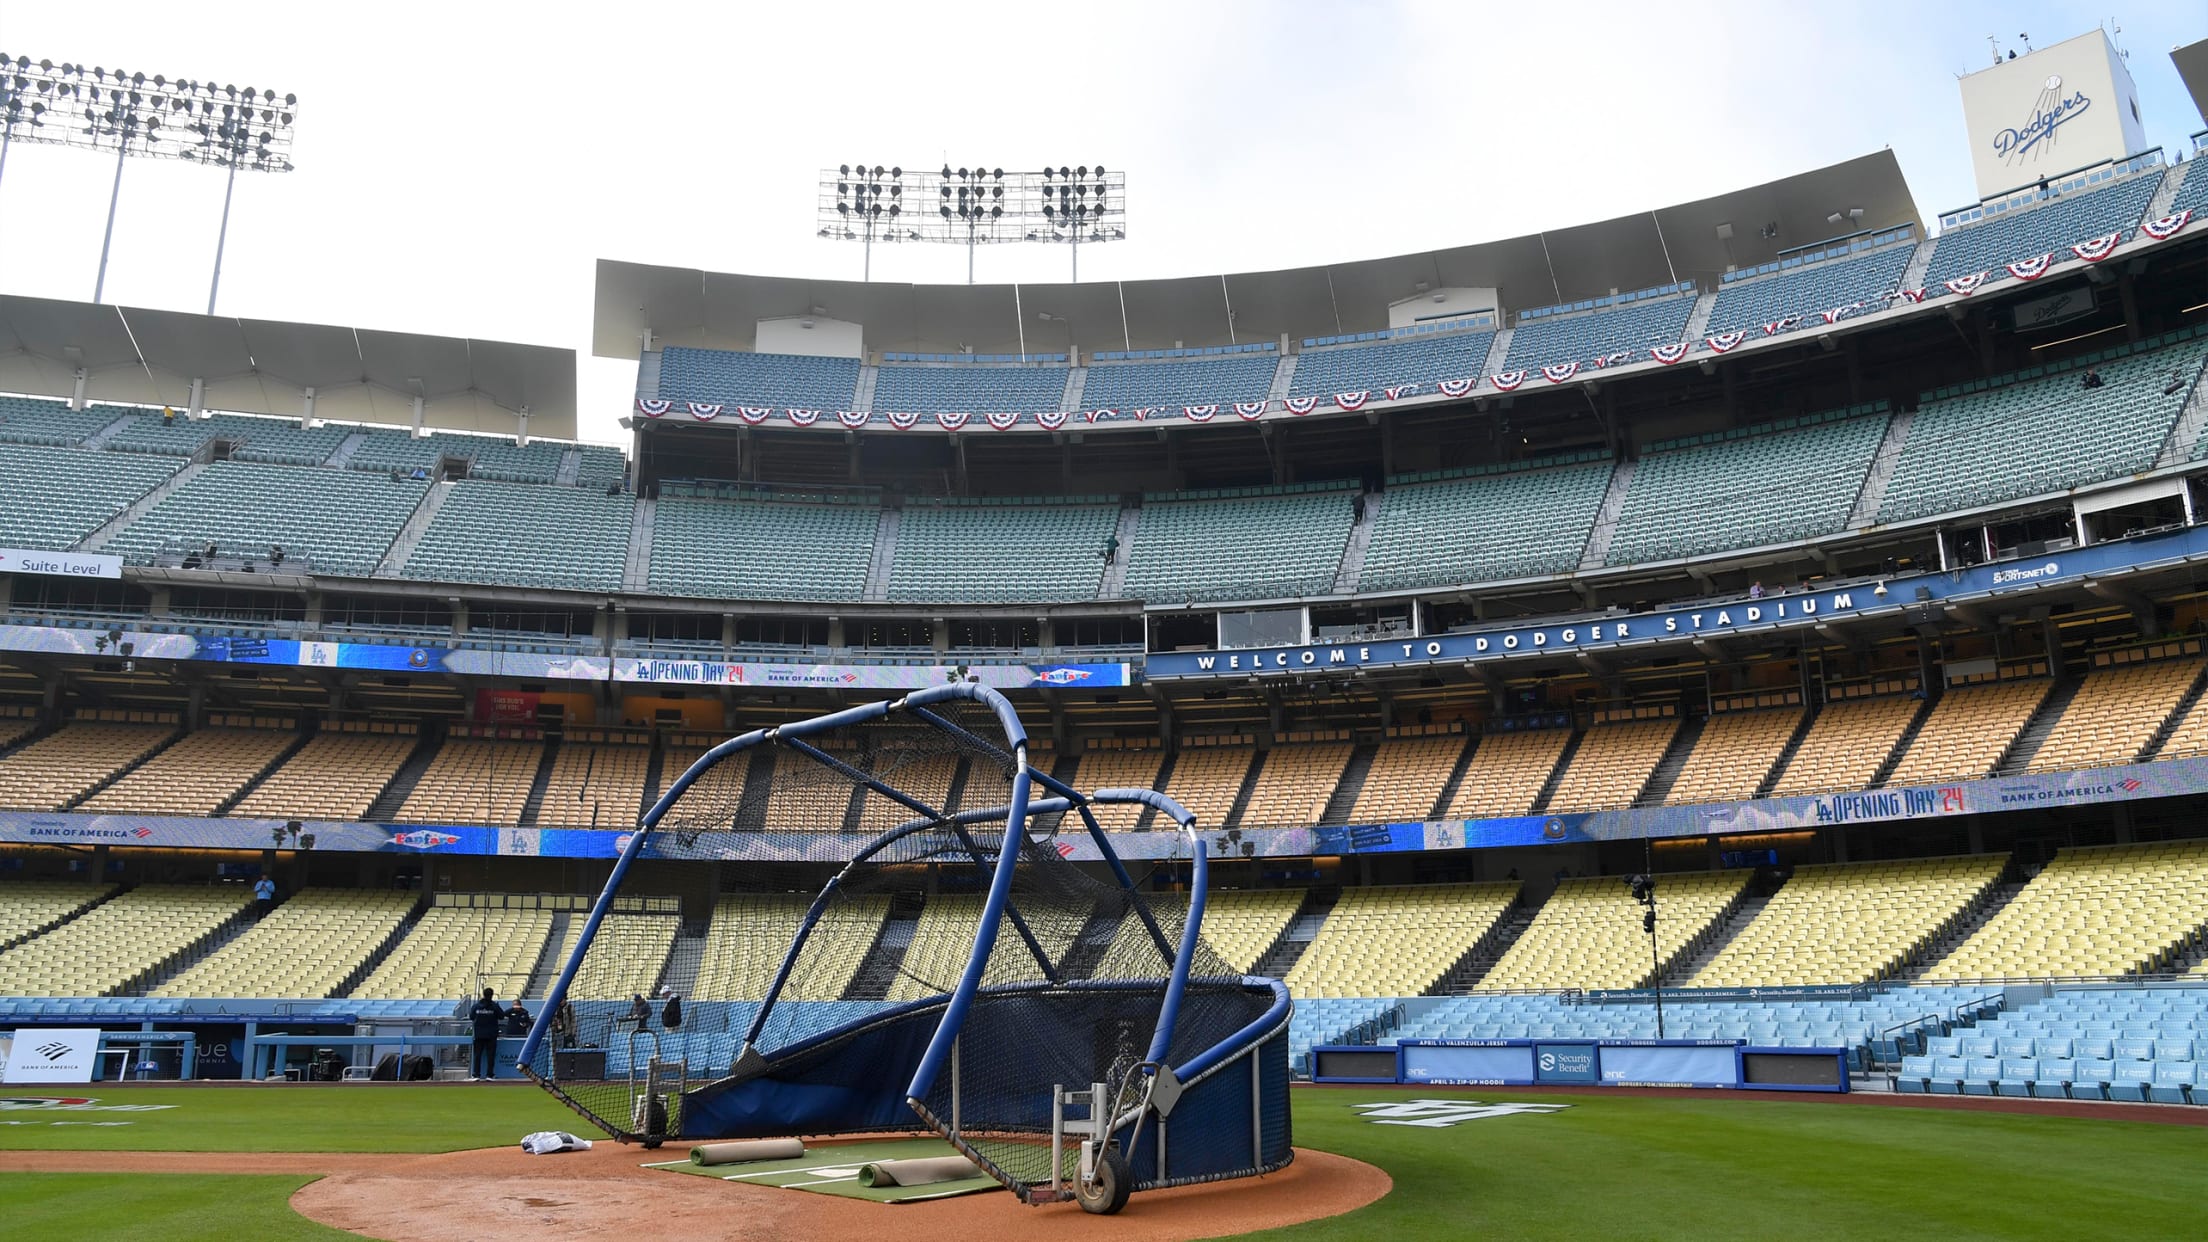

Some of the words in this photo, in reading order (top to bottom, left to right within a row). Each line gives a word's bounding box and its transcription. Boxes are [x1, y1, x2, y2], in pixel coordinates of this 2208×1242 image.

[1993, 91, 2091, 158] Dodgers
[22, 560, 58, 572] Suite
[63, 562, 101, 575] Level
[1993, 568, 2046, 584] SPORTSNET
[1197, 647, 1369, 669] WELCOME
[1402, 641, 1442, 658] TO
[1475, 623, 1630, 651] DODGER
[1665, 593, 1853, 632] STADIUM
[649, 661, 700, 681] OPENING
[702, 662, 725, 683] DAY
[2001, 792, 2035, 803] BANK
[2038, 790, 2055, 800] OF
[2055, 785, 2114, 799] AMERICA
[1832, 793, 1900, 823] OPENING
[1904, 788, 1935, 818] DAY
[30, 828, 60, 836] BANK
[62, 829, 77, 837] OF
[79, 830, 128, 838] AMERICA
[1558, 1053, 1593, 1064] Security
[1559, 1063, 1590, 1073] Benefit
